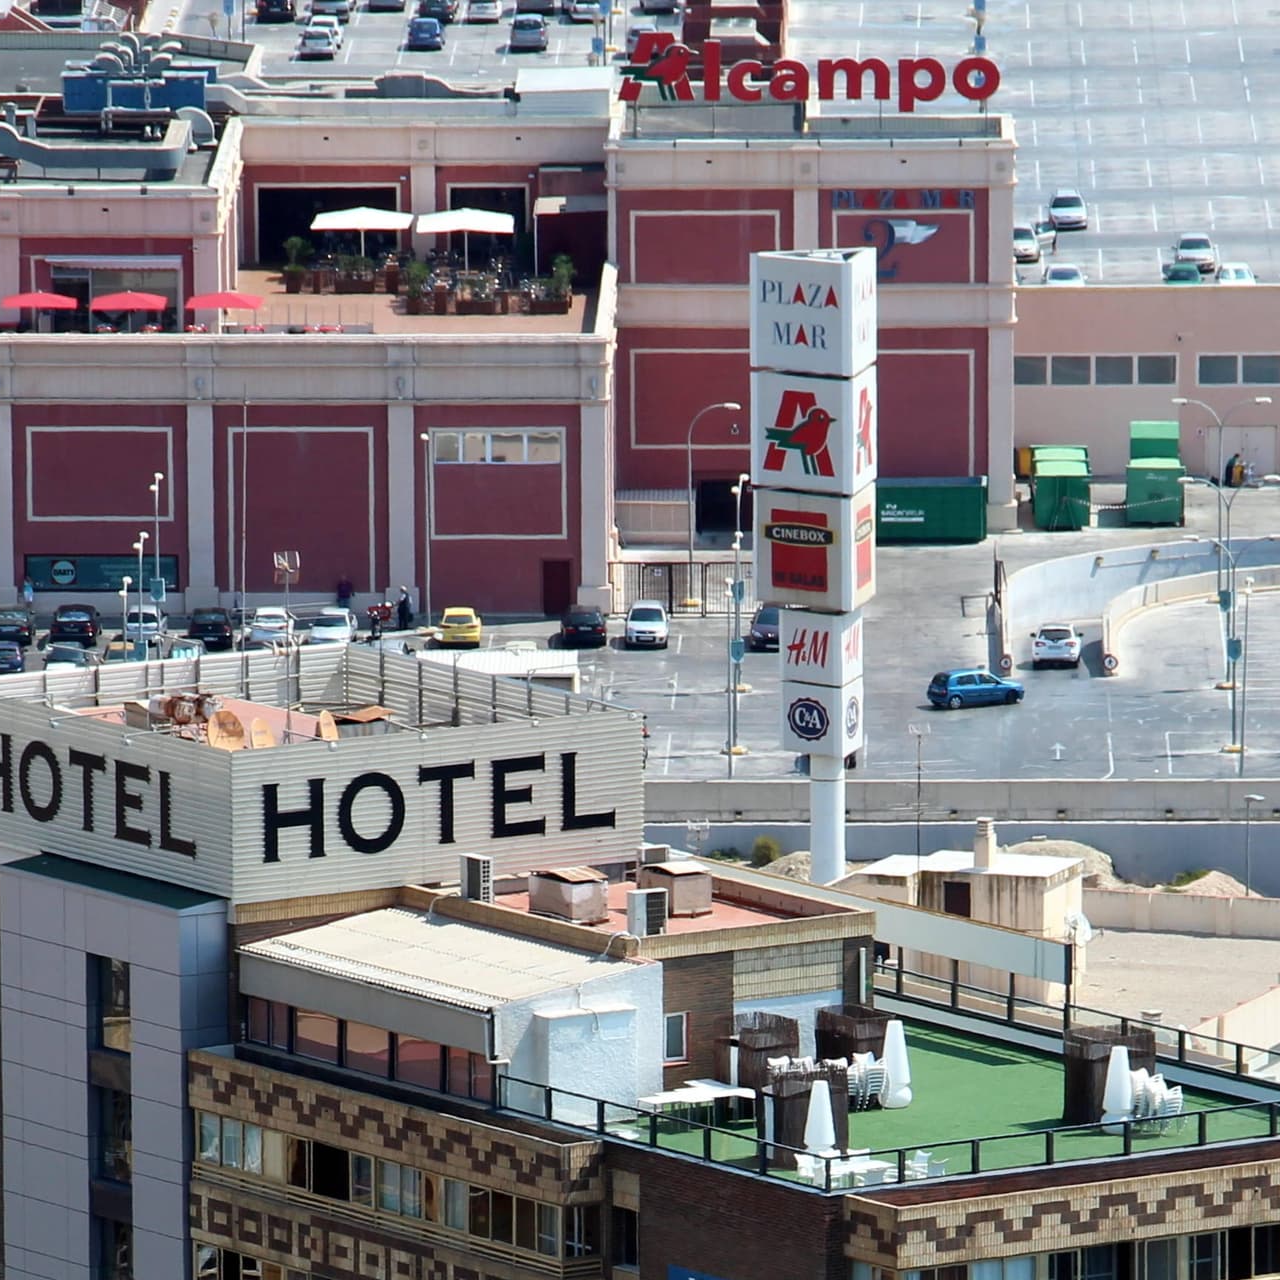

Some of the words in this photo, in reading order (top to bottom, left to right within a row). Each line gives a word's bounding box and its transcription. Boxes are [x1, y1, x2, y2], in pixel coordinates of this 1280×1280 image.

[618, 32, 1001, 113] Alcampo
[832, 190, 910, 209] PLAZA
[922, 190, 976, 209] MAR
[761, 279, 839, 309] PLAZA
[774, 321, 827, 350] MAR
[772, 527, 825, 542] CINEBOX
[787, 628, 829, 669] H&M
[794, 707, 822, 729] C&A
[262, 751, 616, 863] HOTEL
